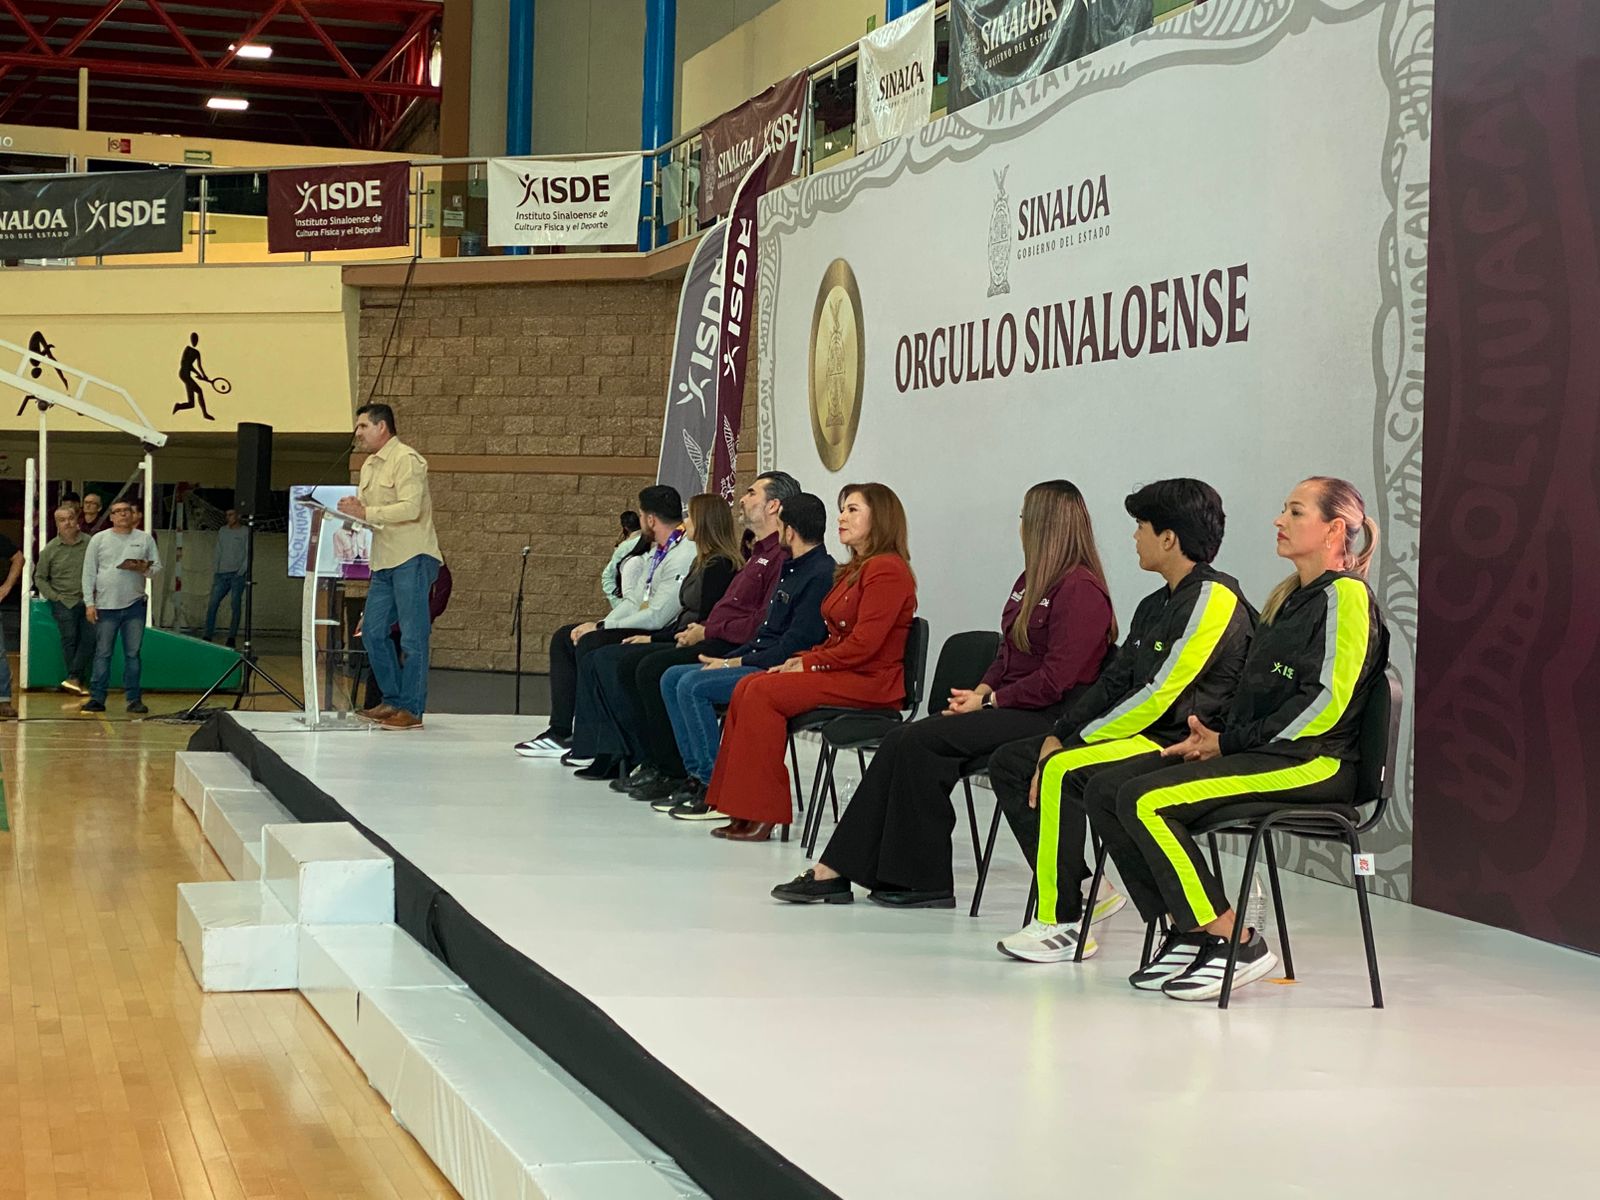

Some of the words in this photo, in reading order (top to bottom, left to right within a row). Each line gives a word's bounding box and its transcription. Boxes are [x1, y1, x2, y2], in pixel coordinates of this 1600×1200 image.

[981, 0, 1058, 55] SINALOA
[1014, 41, 1027, 55] DEL
[717, 136, 754, 179] SINALOA
[319, 179, 382, 211] ISDE
[541, 174, 611, 204] ISDE
[109, 198, 167, 228] ISDE
[295, 217, 328, 227] Instituto
[329, 216, 370, 226] Sinaloense
[372, 213, 382, 223] de
[515, 211, 551, 221] Instituto
[553, 210, 598, 220] Sinaloense
[598, 209, 609, 218] de
[1017, 173, 1111, 241] SINALOA
[36, 231, 69, 239] ESTADO
[340, 229, 346, 237] y
[346, 226, 354, 235] el
[514, 222, 542, 231] Cultura
[566, 223, 572, 233] y
[572, 222, 580, 231] el
[581, 221, 609, 231] Deporte
[1016, 240, 1056, 260] GOBIERNO
[1059, 235, 1075, 250] DEL
[1078, 224, 1111, 244] ESTADO
[726, 217, 753, 338] ISDE
[894, 311, 1018, 394] ORGULLO
[1023, 261, 1250, 374] SINALOENSE
[289, 487, 308, 559] COLHUACN
